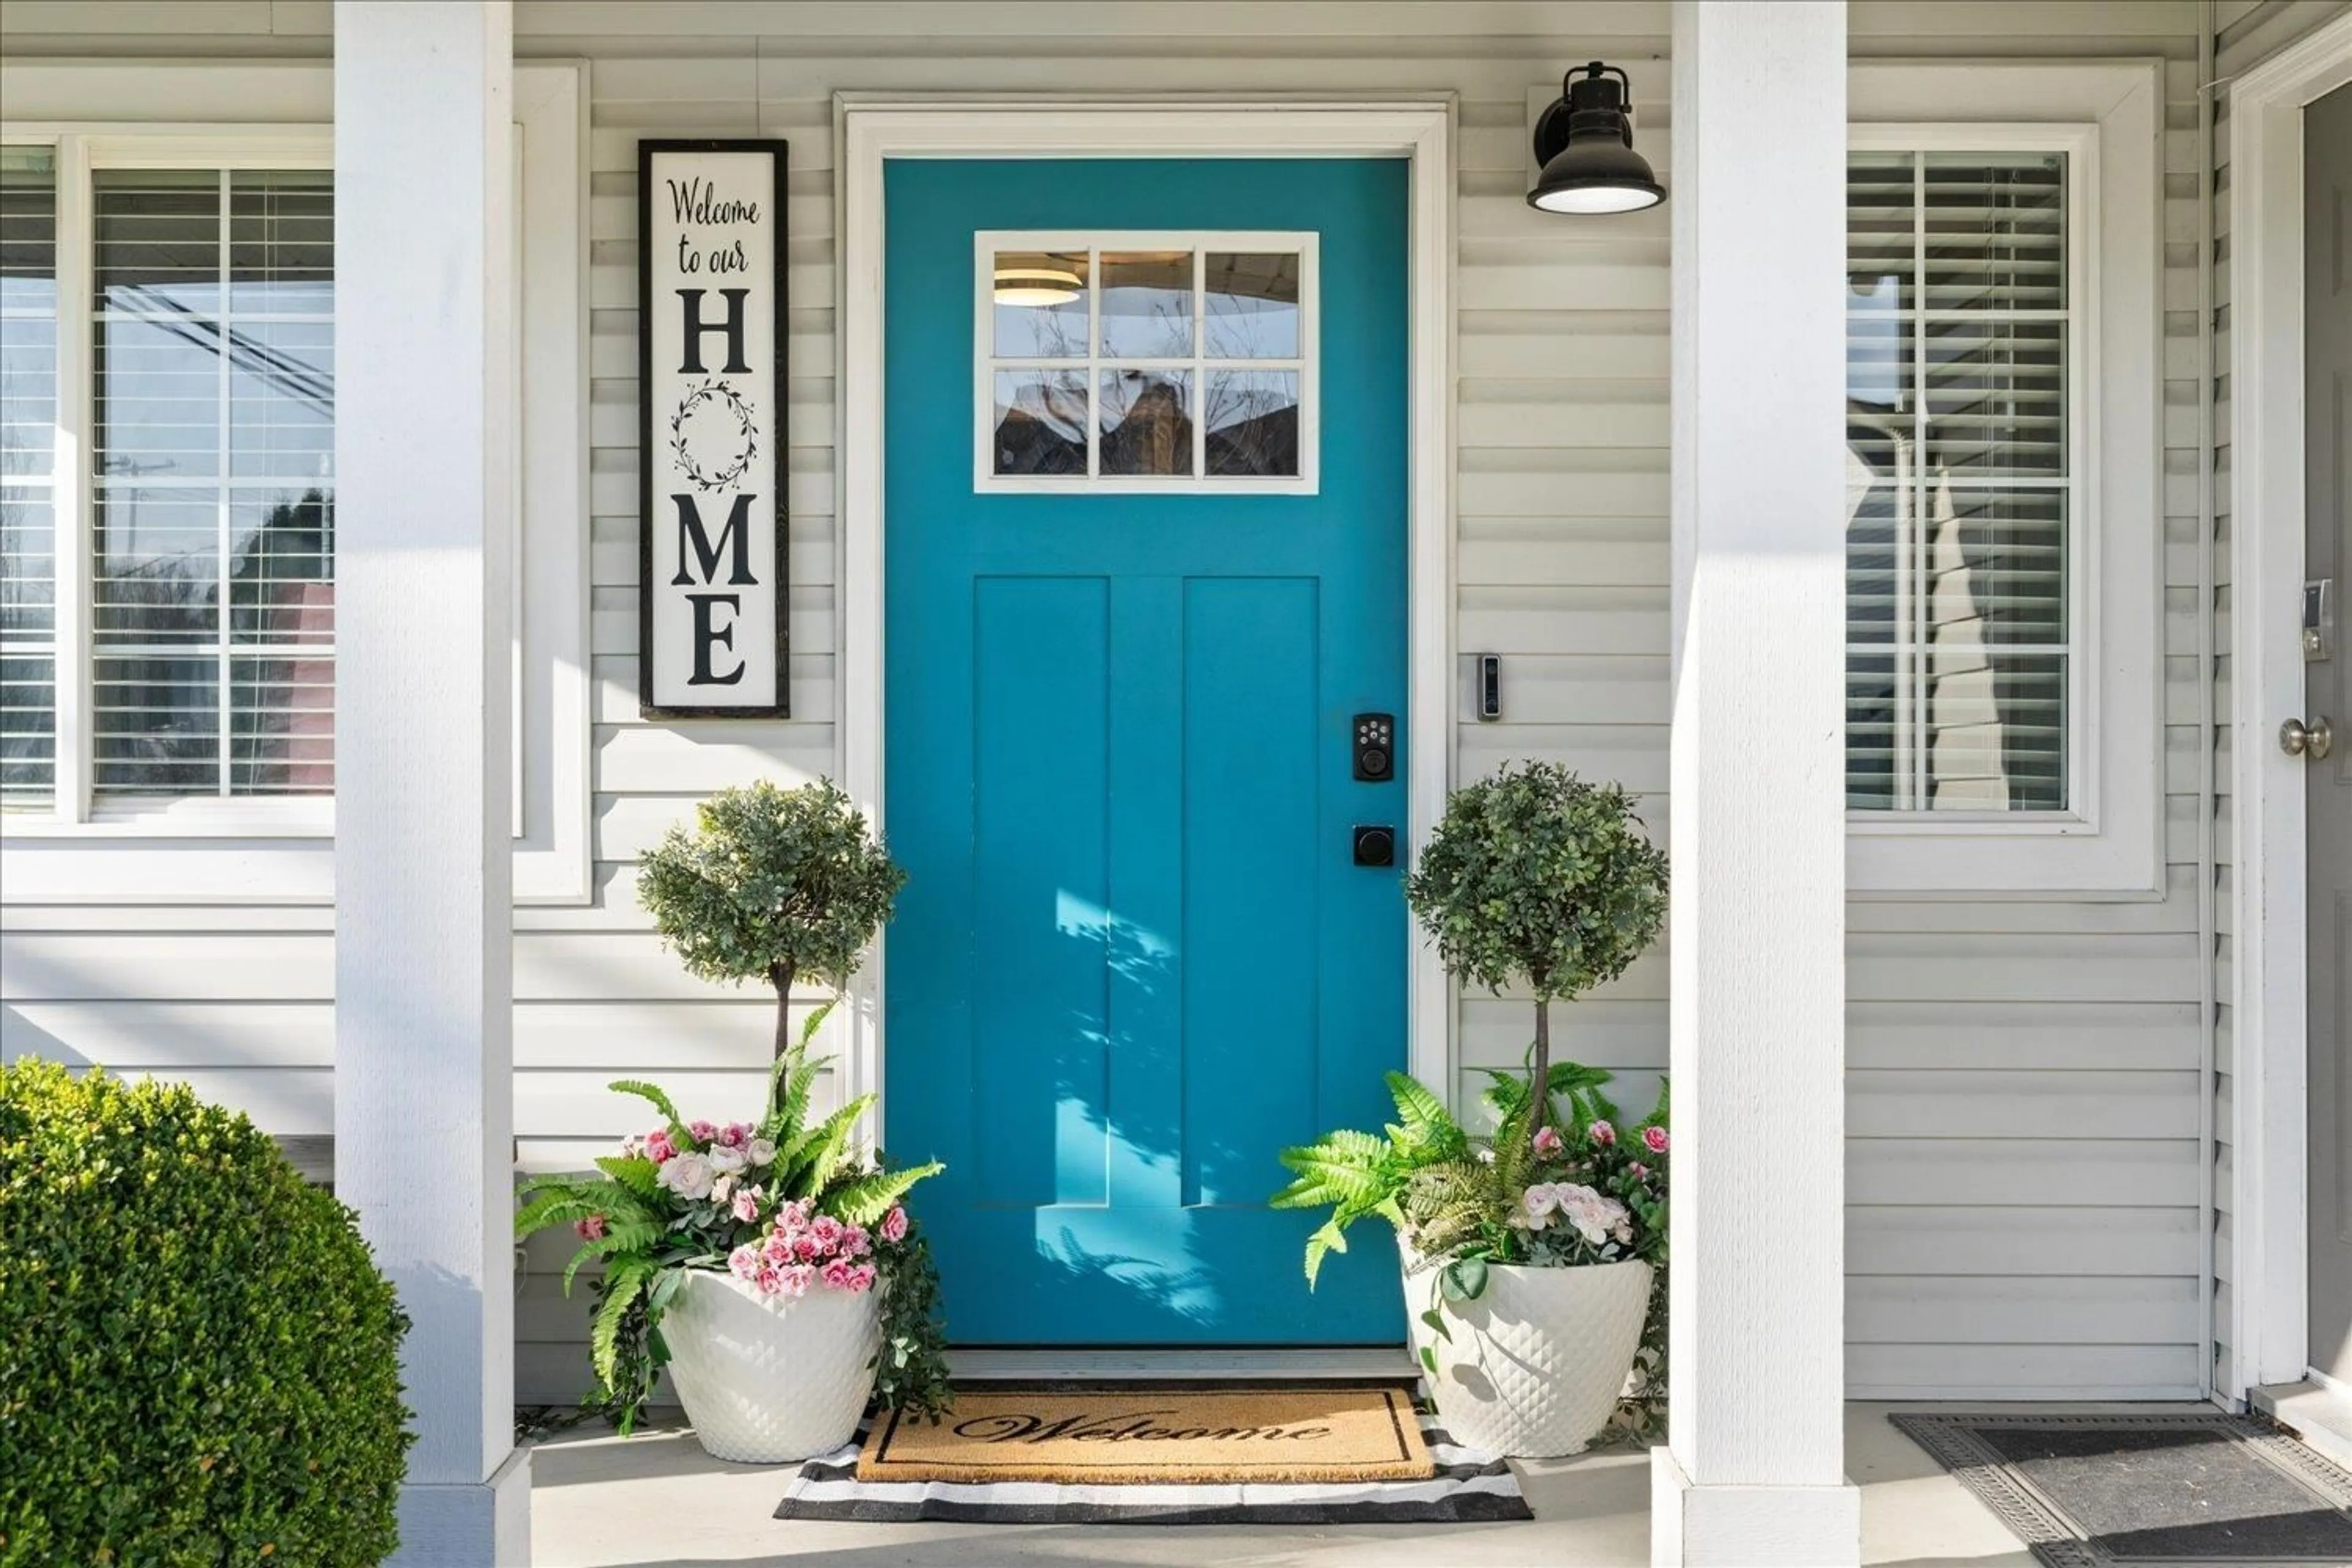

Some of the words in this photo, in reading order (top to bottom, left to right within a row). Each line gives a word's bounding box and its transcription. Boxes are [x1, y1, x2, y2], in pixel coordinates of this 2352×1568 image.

[666, 176, 761, 225] Welcome
[679, 233, 701, 274] to
[709, 239, 749, 274] our
[952, 1409, 1333, 1444] Welcome
